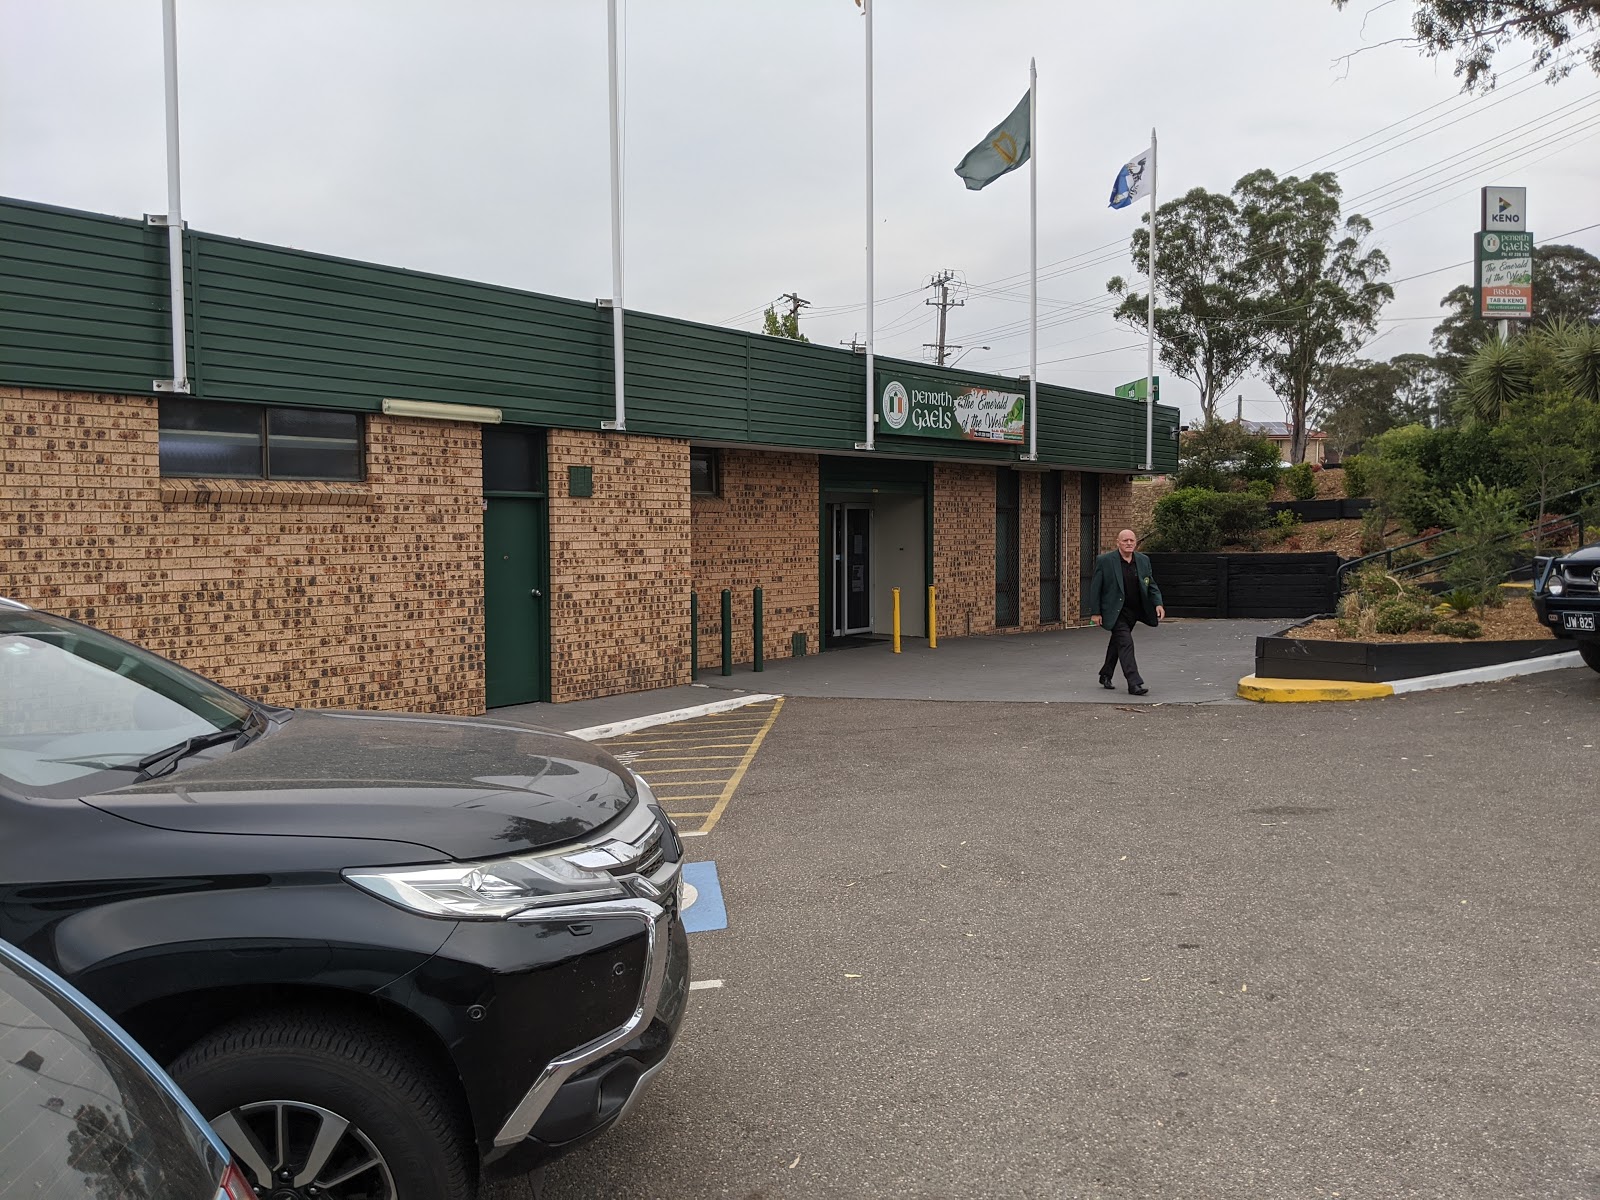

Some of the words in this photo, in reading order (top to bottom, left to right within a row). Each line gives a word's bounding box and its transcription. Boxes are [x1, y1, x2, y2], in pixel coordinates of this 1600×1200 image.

[1492, 214, 1519, 222] KENO
[1501, 241, 1529, 251] Gaels
[1485, 263, 1496, 273] The
[1499, 260, 1528, 271] Emerald
[1485, 274, 1493, 284] of
[1493, 273, 1504, 282] the
[1506, 271, 1529, 280] West
[958, 394, 975, 410] The
[978, 394, 1008, 410] Emerald
[962, 414, 969, 433] of
[971, 414, 981, 428] the
[985, 412, 1008, 428] West
